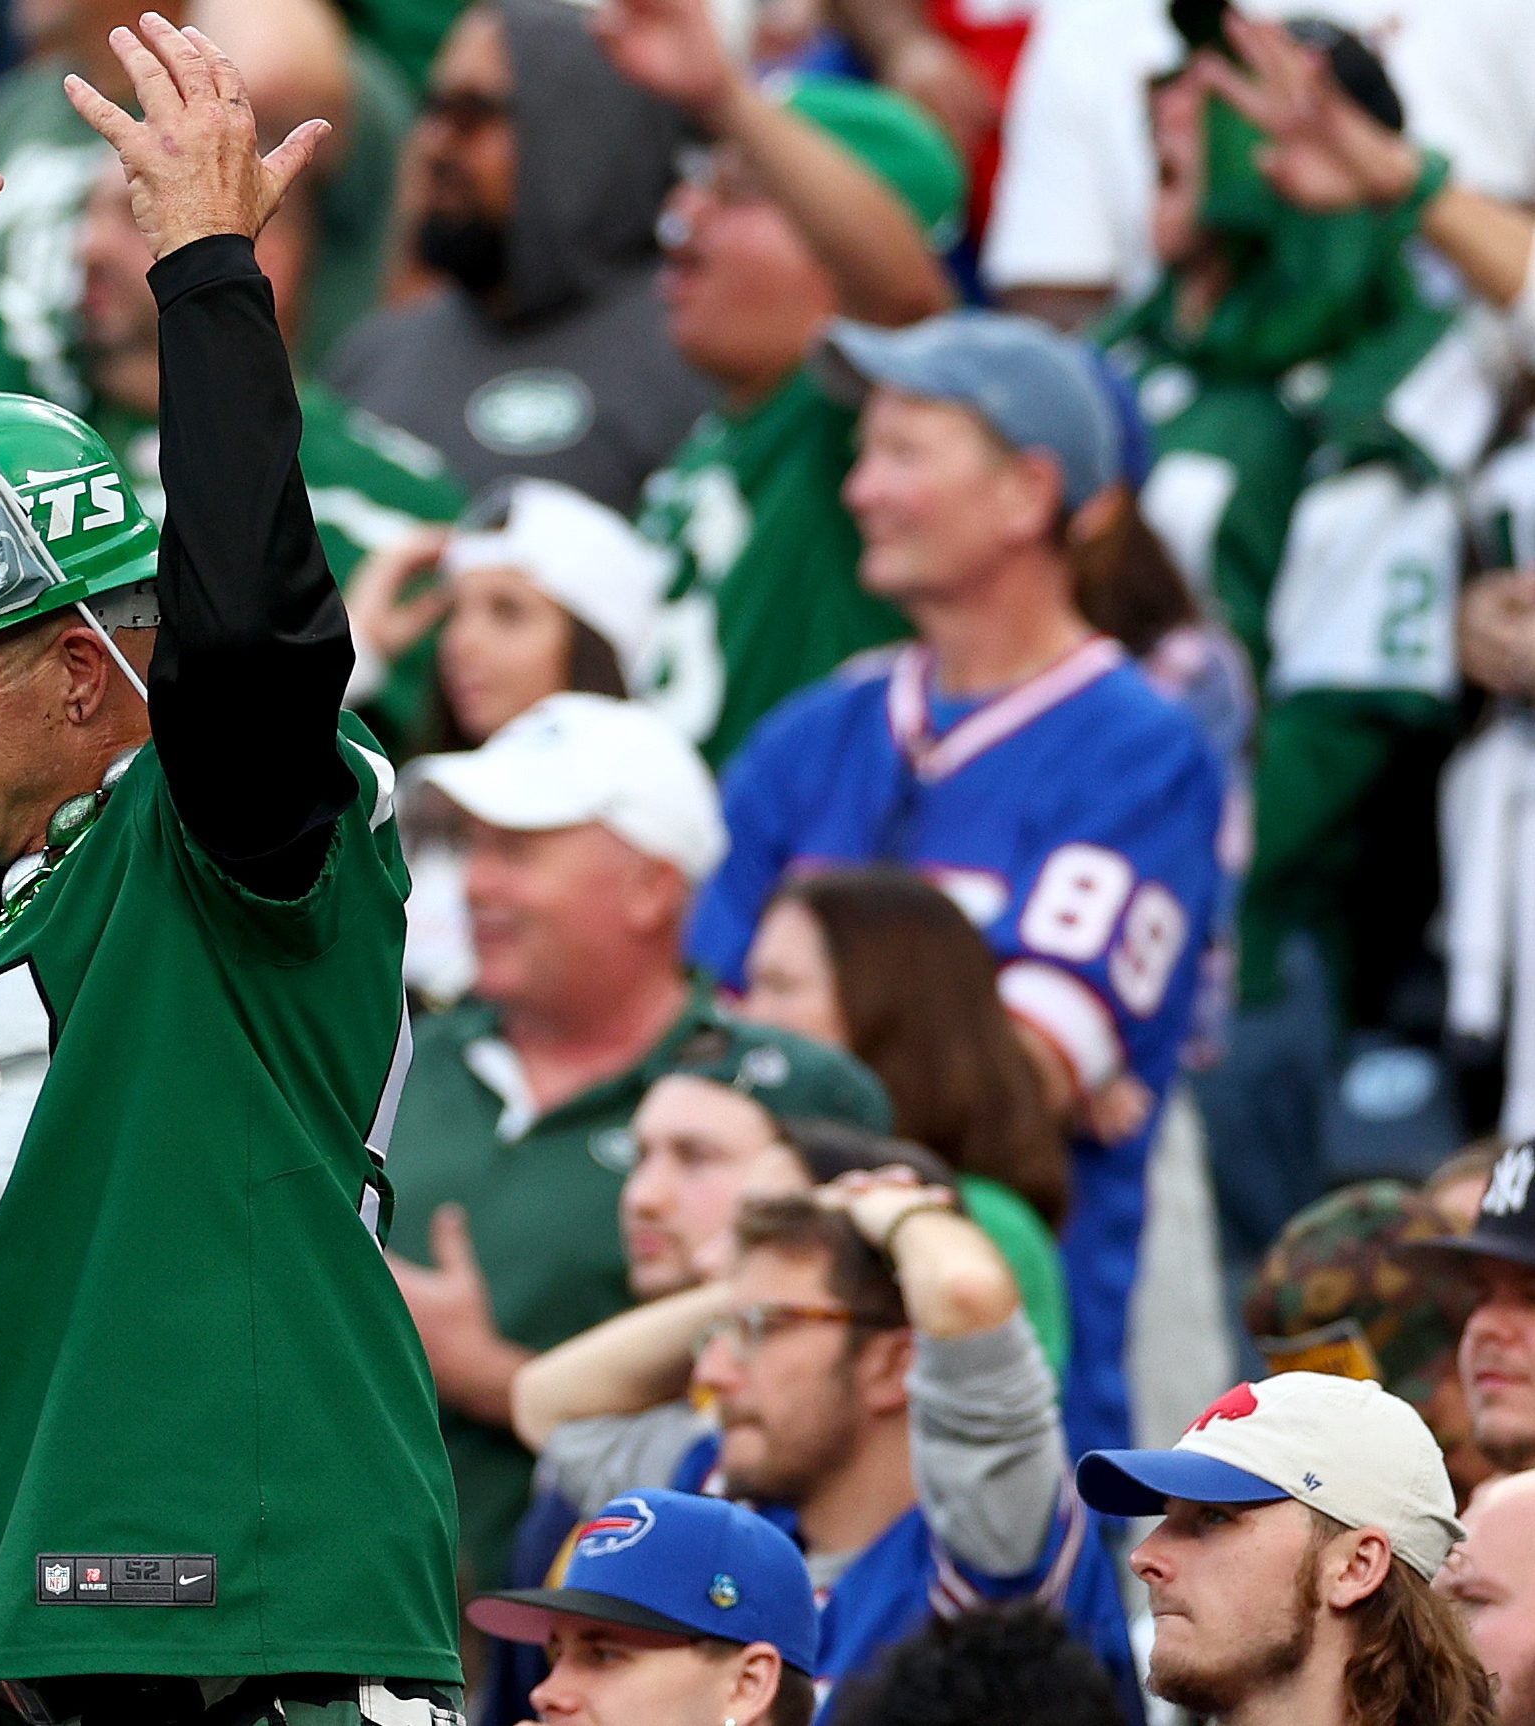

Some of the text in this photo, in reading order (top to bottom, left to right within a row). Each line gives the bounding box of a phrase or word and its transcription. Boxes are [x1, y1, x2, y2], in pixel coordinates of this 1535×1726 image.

[1018, 838, 1192, 1021] 89
[125, 1560, 161, 1580] 52
[48, 1577, 66, 1589] NFL
